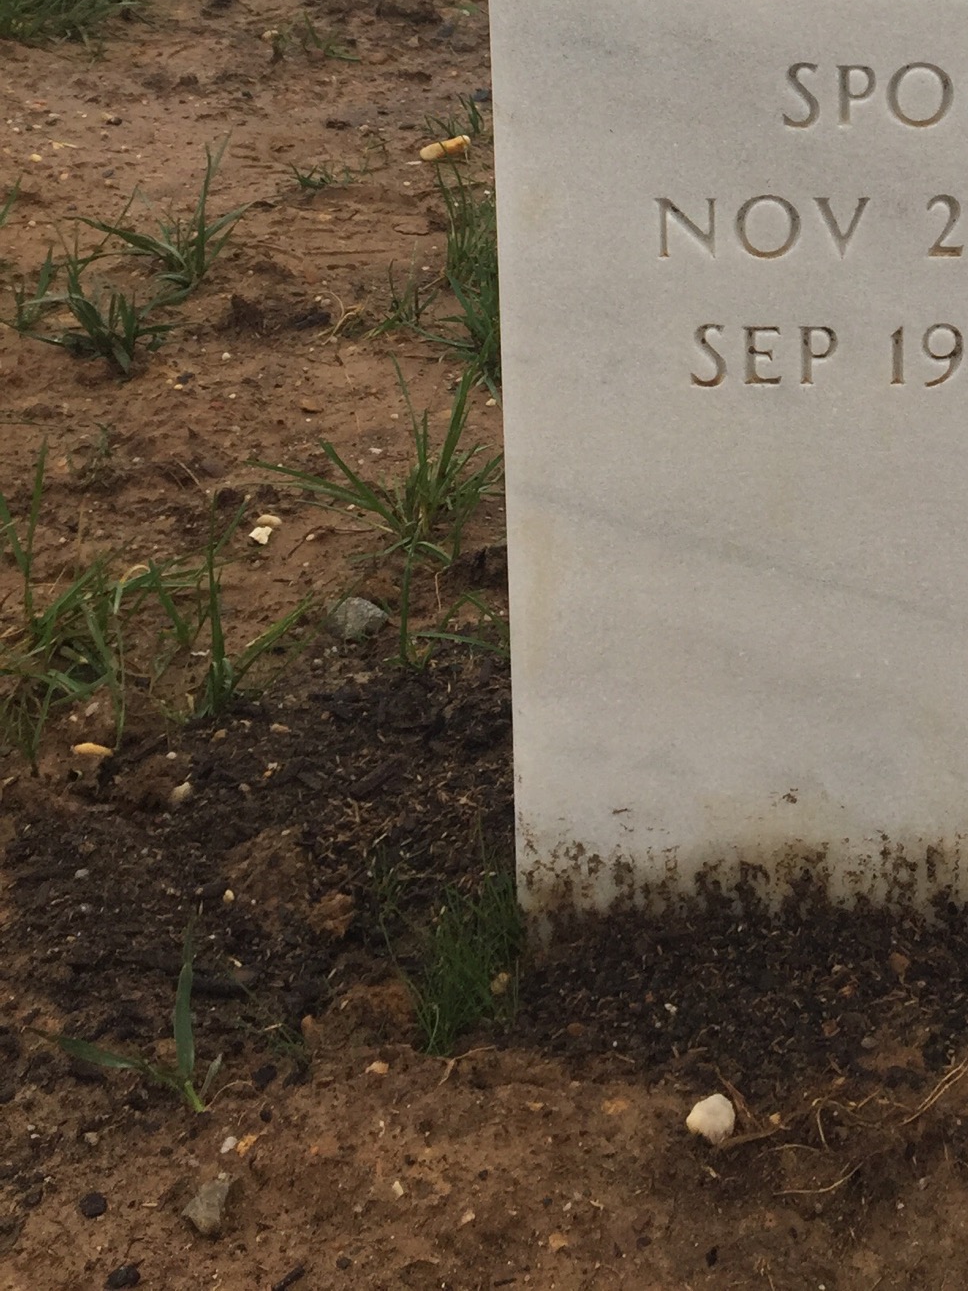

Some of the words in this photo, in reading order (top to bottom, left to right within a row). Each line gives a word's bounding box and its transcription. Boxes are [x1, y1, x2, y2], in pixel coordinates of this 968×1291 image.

[654, 194, 870, 259] NOV
[690, 323, 838, 388] SEP
[890, 322, 965, 388] 19
